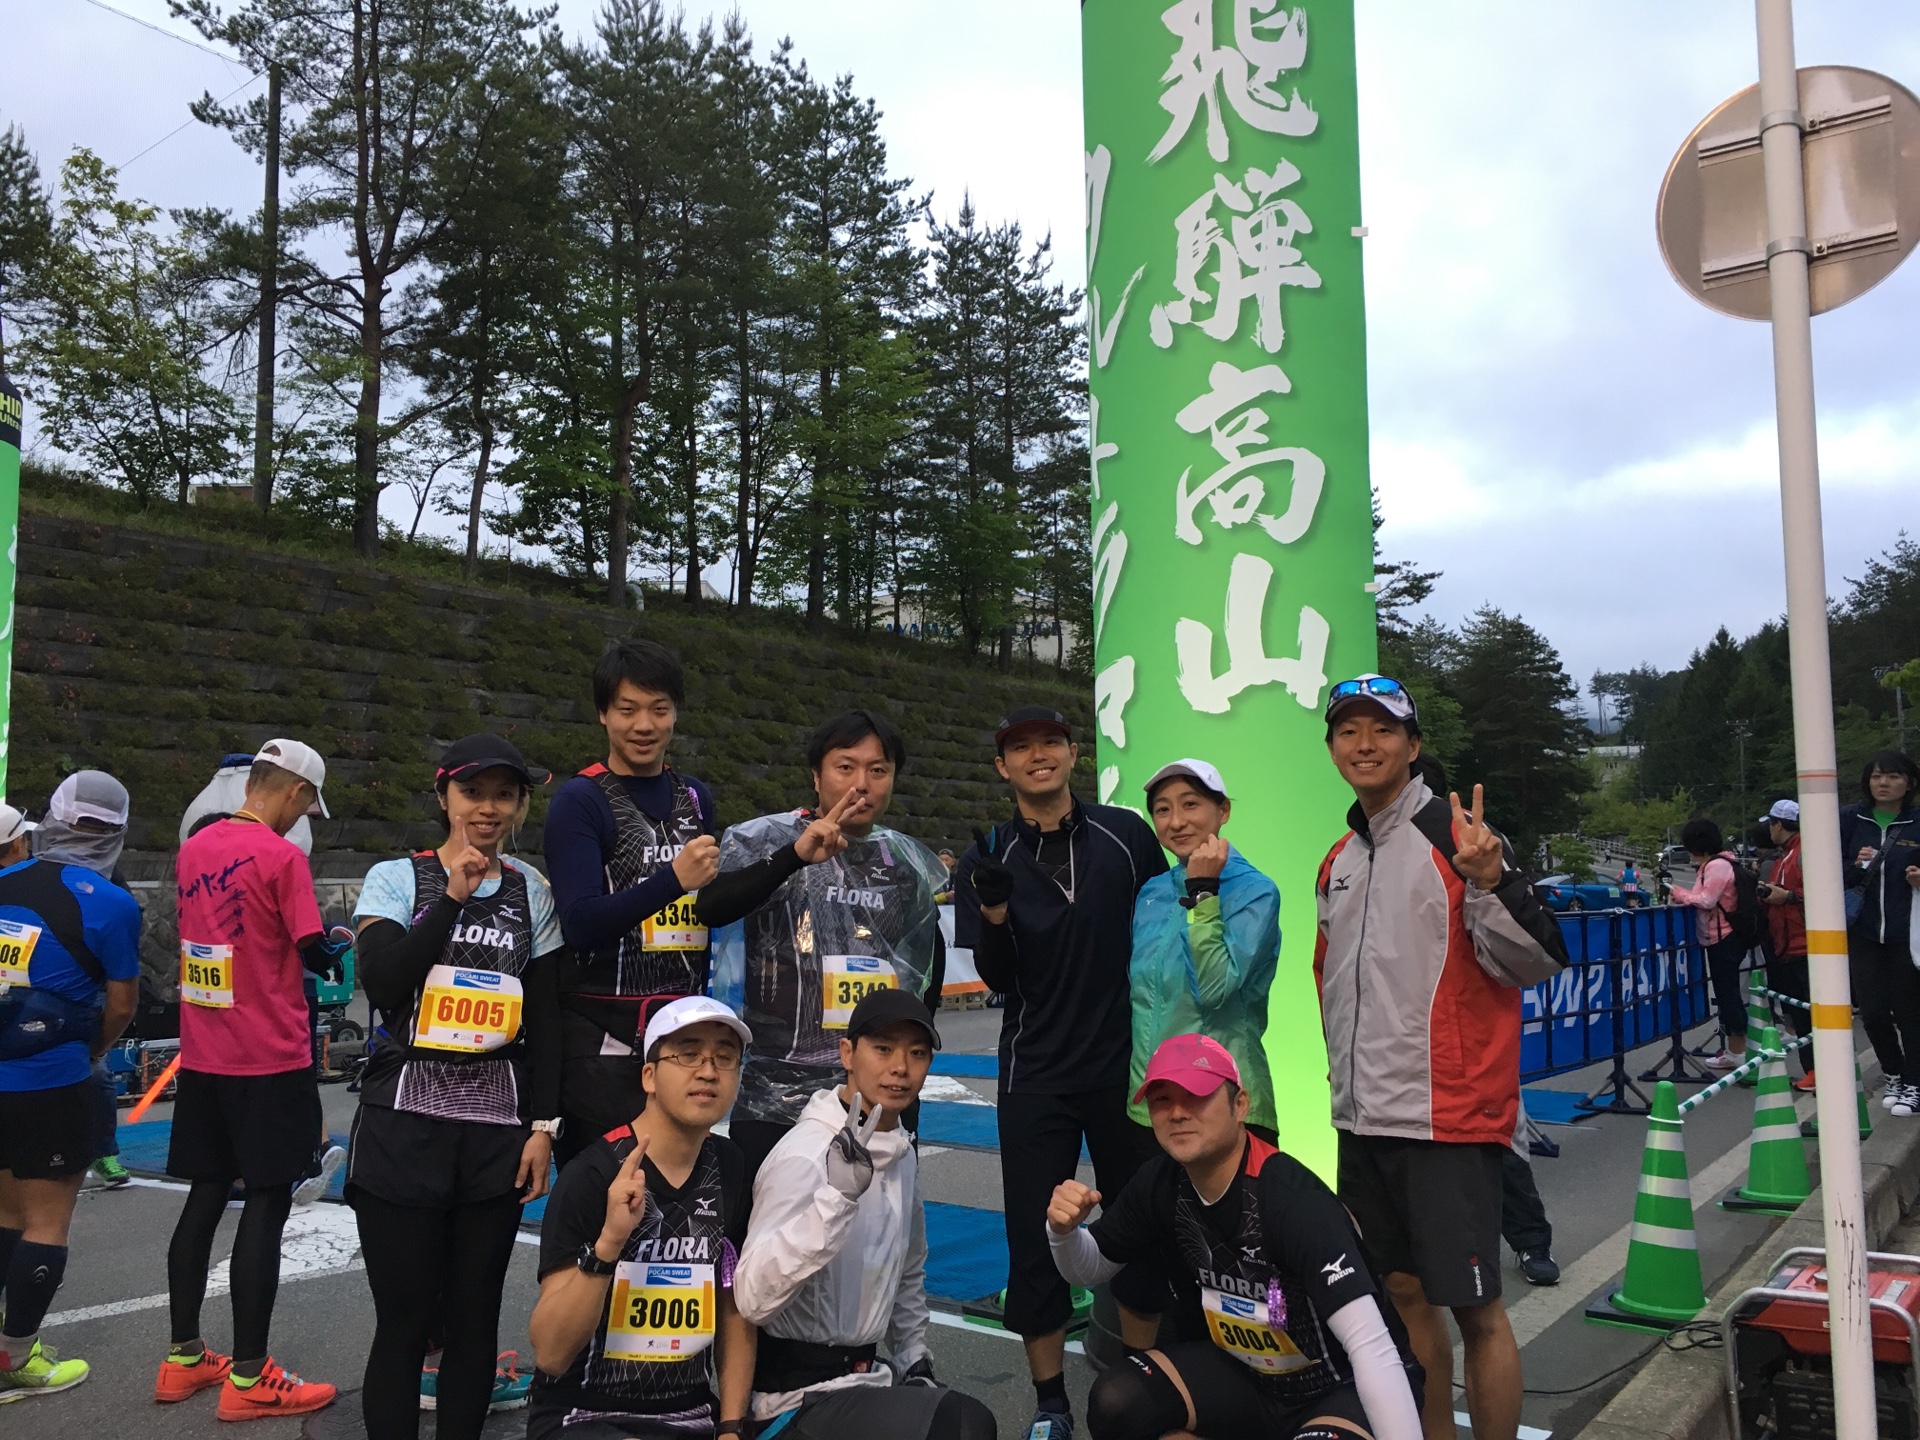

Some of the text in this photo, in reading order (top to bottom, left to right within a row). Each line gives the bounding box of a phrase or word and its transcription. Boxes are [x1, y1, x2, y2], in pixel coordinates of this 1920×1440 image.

[1145, 0, 1330, 714] 飛騨高山
[826, 886, 885, 910] FLORA
[448, 923, 514, 951] LORA
[187, 962, 221, 987] 3516
[437, 995, 505, 1028] 6005
[634, 1236, 709, 1262] FLORA
[1198, 1267, 1269, 1300] FLORA
[1472, 1265, 1483, 1296] Reebok
[629, 1297, 700, 1329] 3006
[1218, 1321, 1280, 1351] 3004
